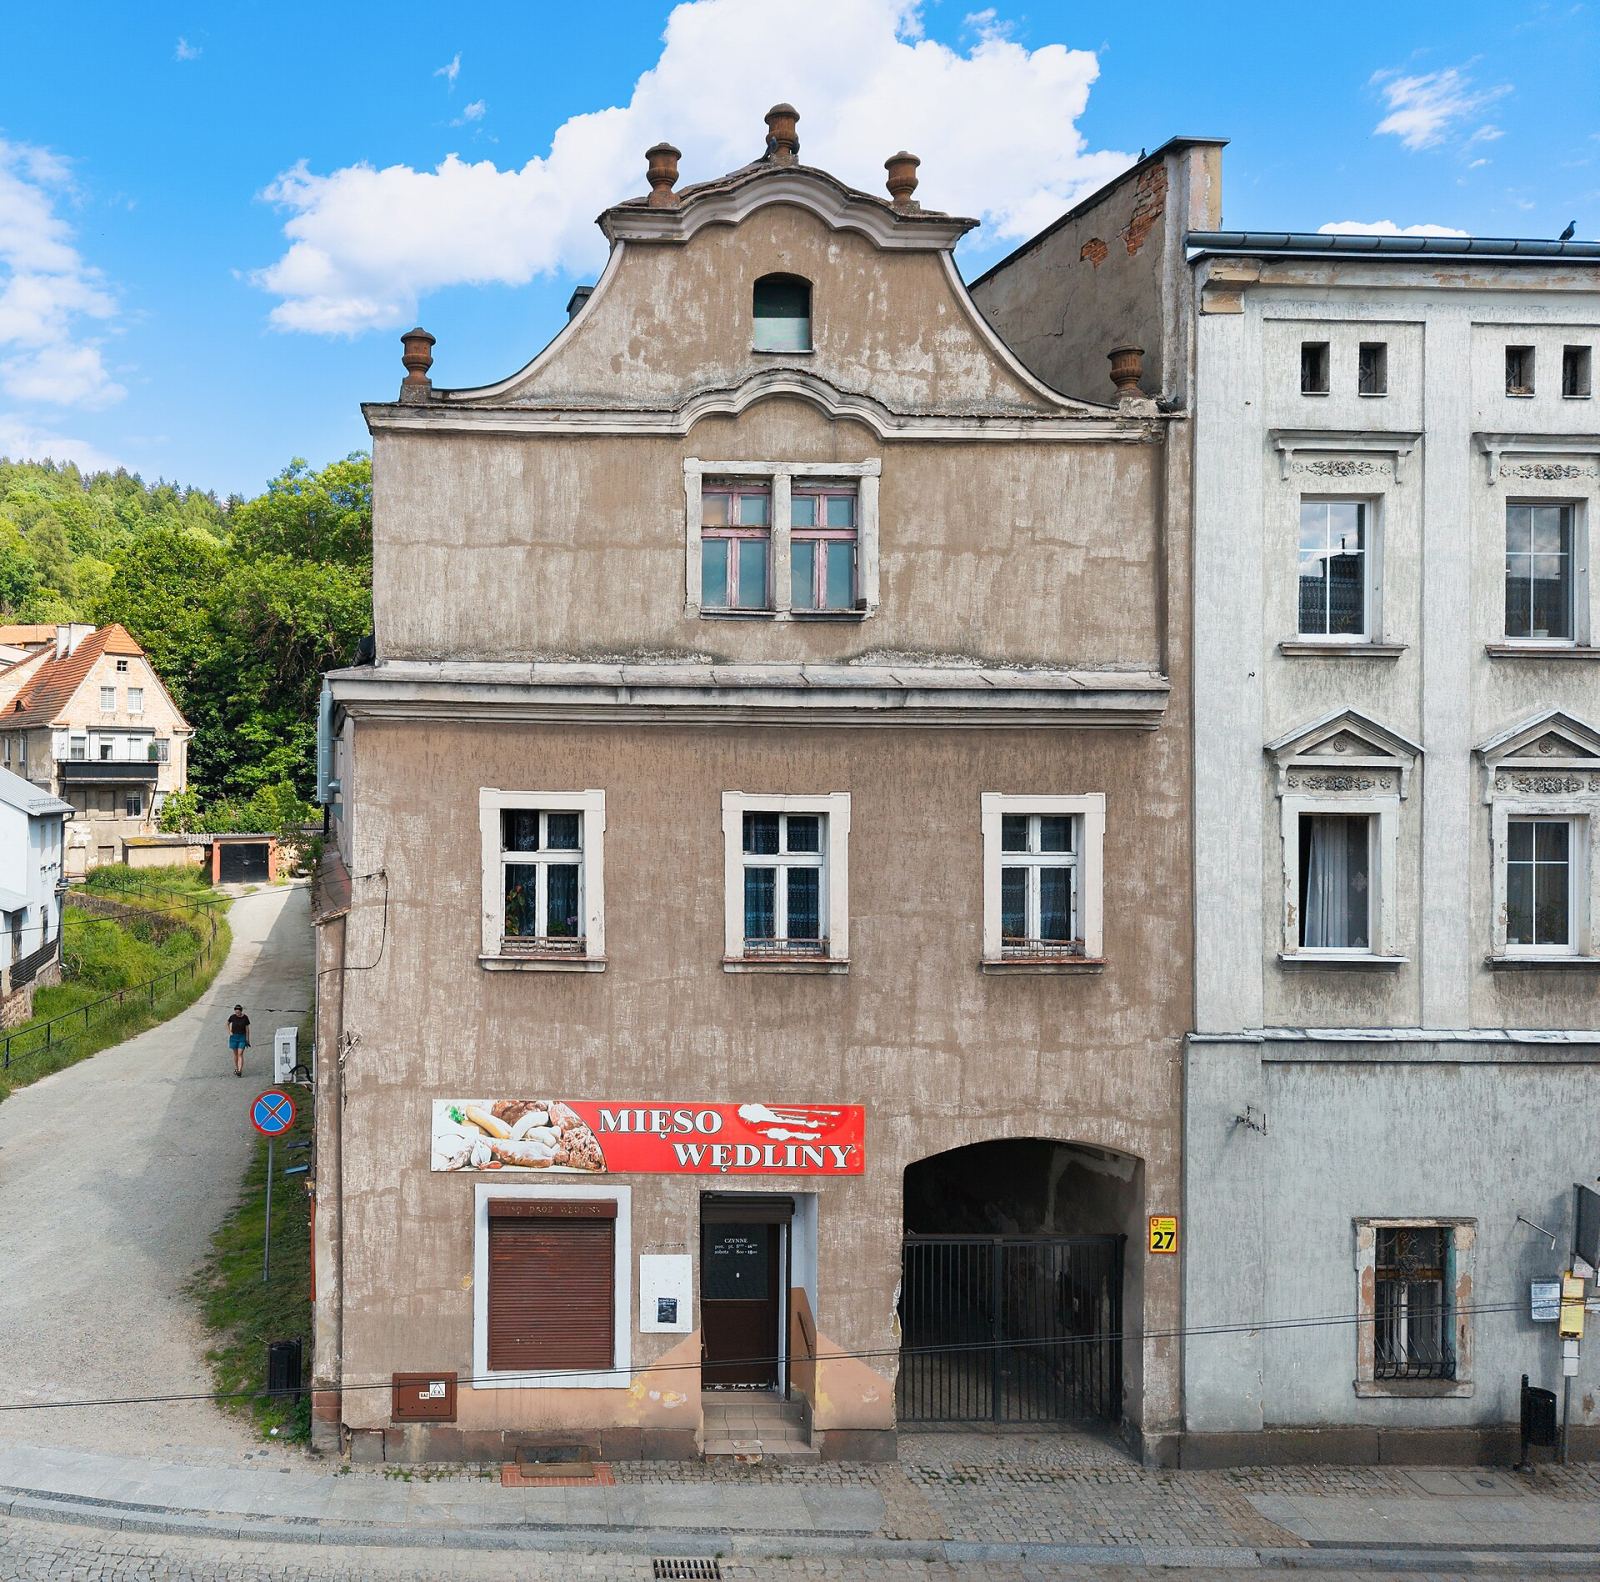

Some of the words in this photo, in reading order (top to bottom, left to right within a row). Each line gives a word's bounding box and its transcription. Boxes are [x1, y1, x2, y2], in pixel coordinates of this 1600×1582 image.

[598, 1109, 723, 1140] MIĘSO
[673, 1143, 852, 1172] WĘDLINY
[1152, 1232, 1175, 1249] 27
